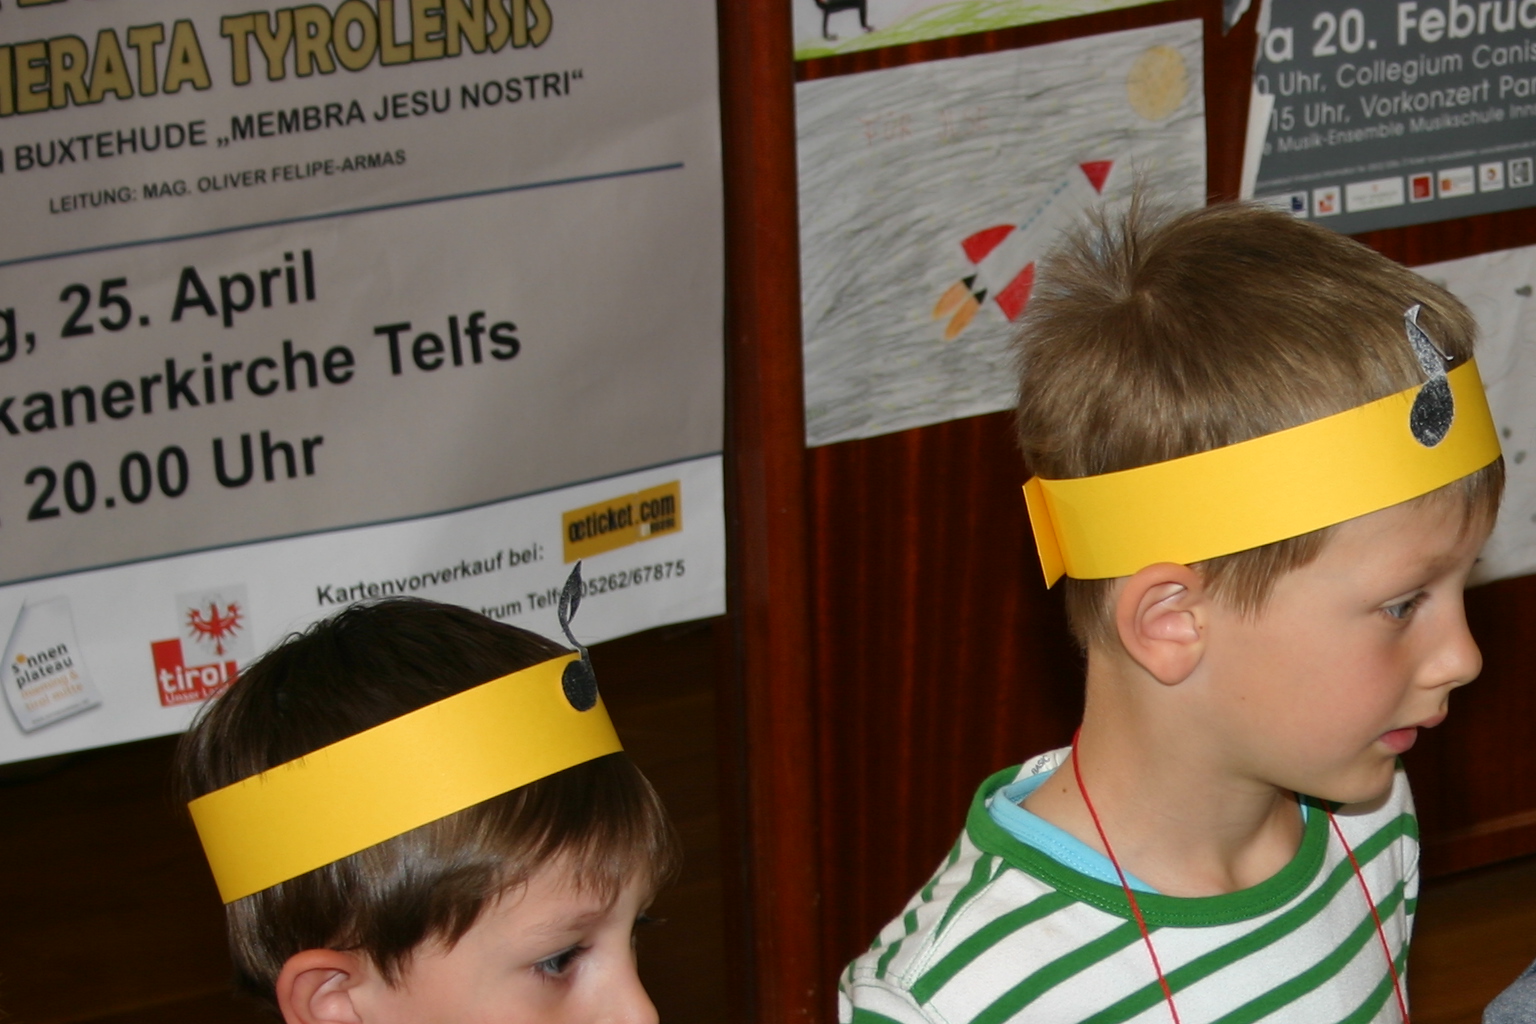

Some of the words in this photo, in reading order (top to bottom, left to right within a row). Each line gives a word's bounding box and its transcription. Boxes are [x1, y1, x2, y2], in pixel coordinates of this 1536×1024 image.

[220, 0, 553, 86] TYROLENSIS
[1312, 8, 1377, 57] 20.
[1278, 70, 1327, 97] Uhr,
[1336, 52, 1463, 89] Collegium
[15, 119, 207, 171] BUXTEHUDE
[374, 87, 451, 121] JESU
[1276, 119, 1405, 151] Musik-Ensemble
[1408, 104, 1505, 133] Musikschule
[1303, 101, 1350, 128] Uhr,
[1360, 79, 1491, 119] Vorkonzert
[49, 187, 137, 214] LEITUNG:
[143, 179, 192, 199] MAG.
[197, 168, 266, 193] OLIVER
[272, 149, 406, 181] FELIPE-ARMAS
[59, 277, 150, 338] 25.
[170, 249, 316, 329] April
[375, 312, 521, 377] Telfs
[24, 445, 189, 522] 20.00
[212, 429, 324, 489] Uhr
[316, 552, 503, 606] Kartenvorverkauf
[508, 544, 544, 568] bei:
[527, 588, 560, 612] Telf
[16, 656, 73, 690] plateau
[159, 662, 228, 694] tirol
